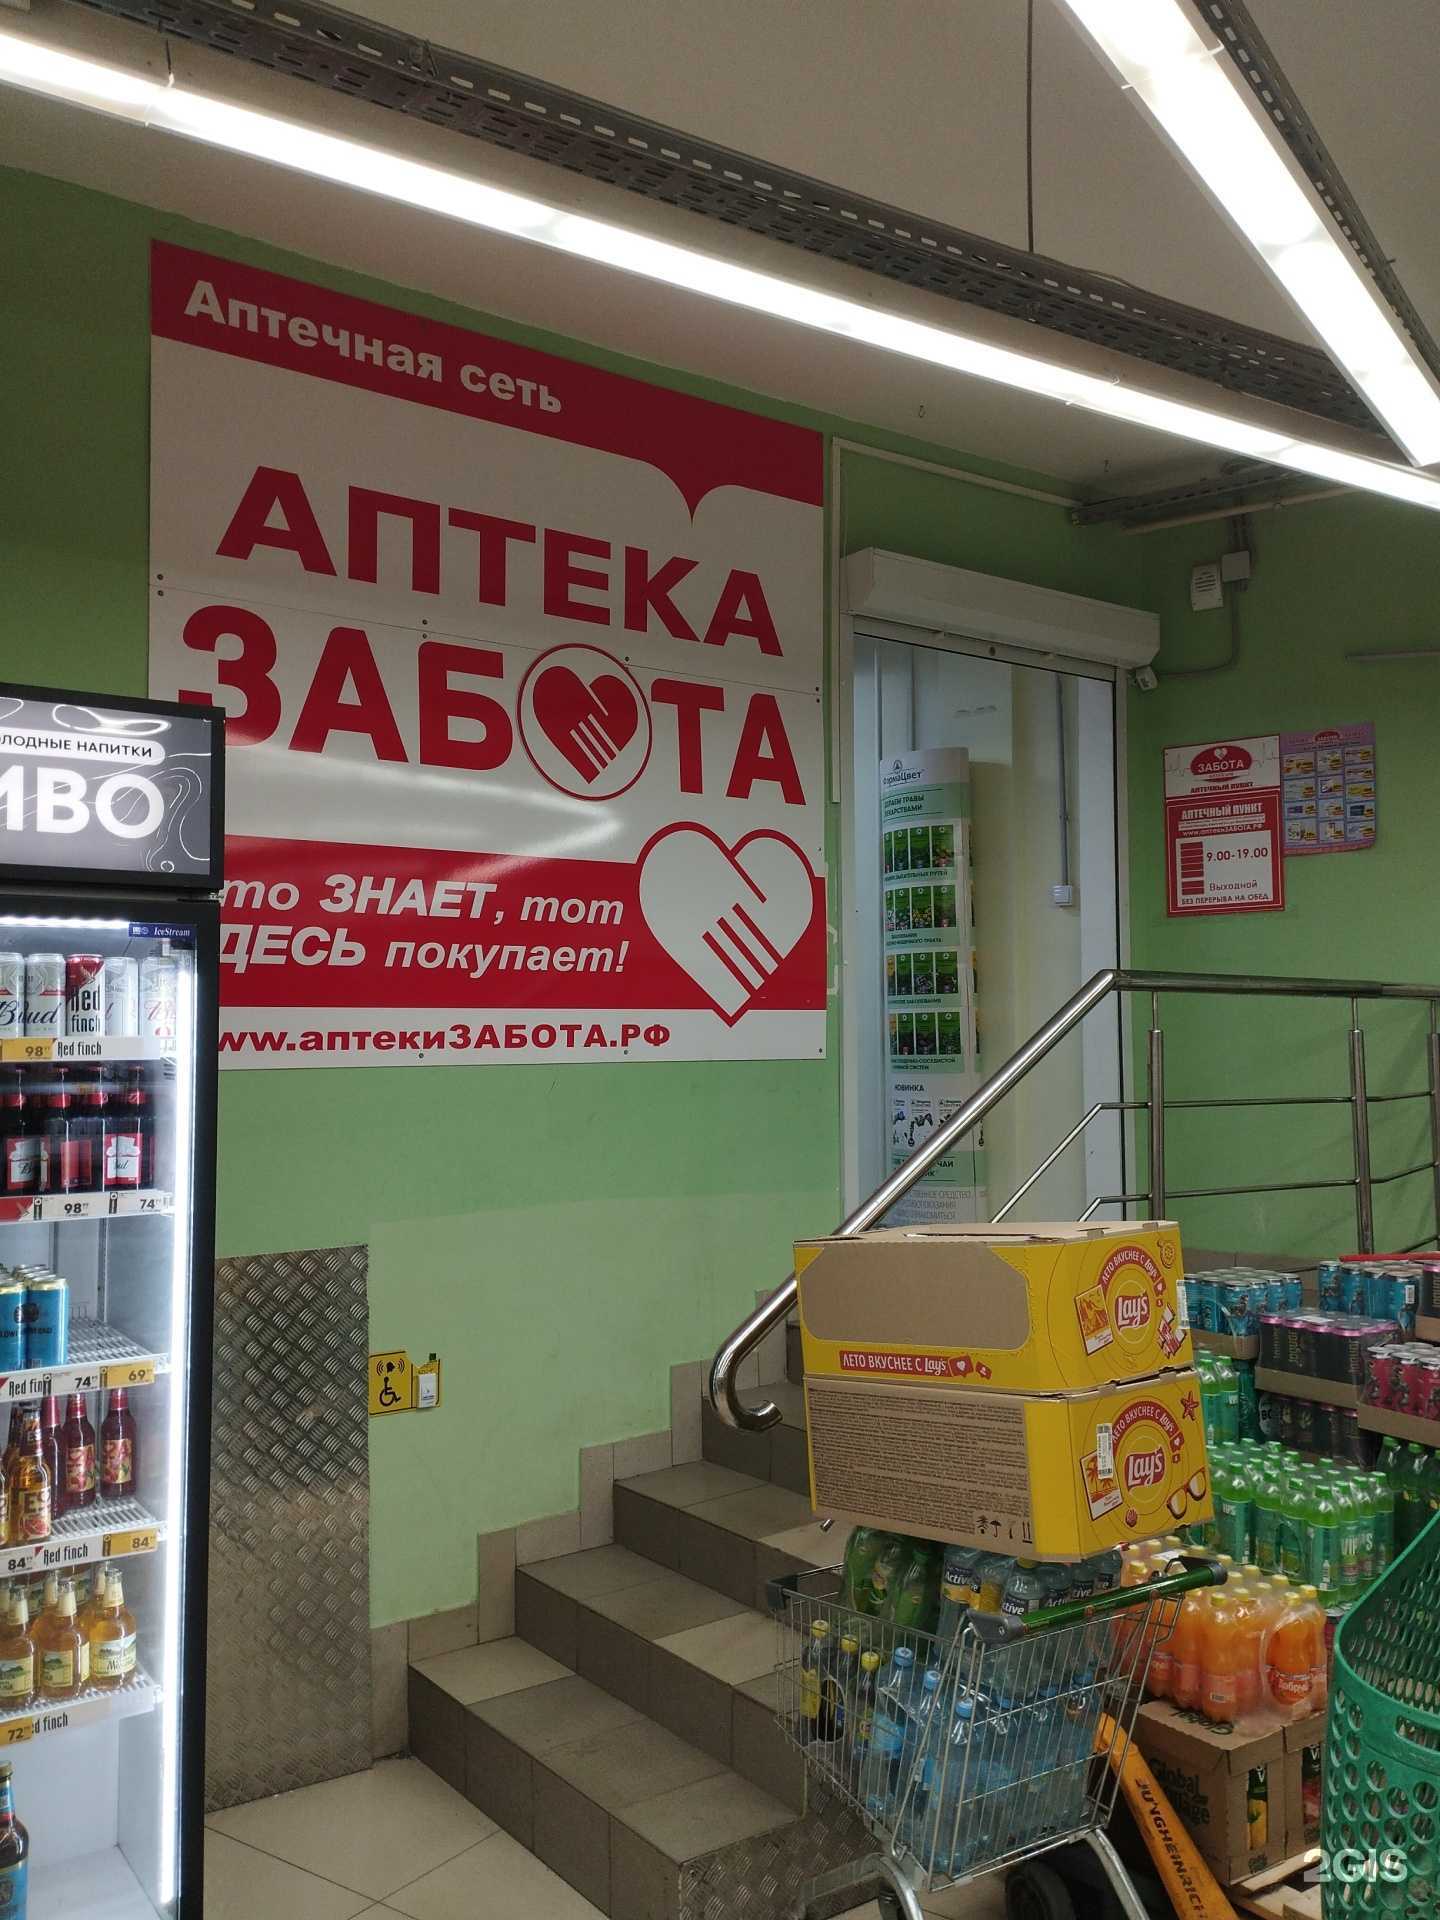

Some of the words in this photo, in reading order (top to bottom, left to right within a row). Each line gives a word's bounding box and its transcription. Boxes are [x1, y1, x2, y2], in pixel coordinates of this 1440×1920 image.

[183, 279, 443, 383] Аптечная
[459, 362, 563, 414] сеть
[214, 465, 784, 657] АПТЕКА
[0, 734, 71, 752] ЛОДНЫЕ
[77, 741, 153, 758] НАПИТКИ
[1197, 759, 1245, 774] ЗАБОТА
[0, 765, 165, 839] ИВО
[1181, 804, 1232, 820] АПТЕЧНЫЙ
[1232, 802, 1263, 815] ПУНКТ
[1206, 847, 1269, 862] 9.00-19.00
[1209, 880, 1258, 892] Выходной
[219, 879, 300, 911] то
[319, 874, 503, 925] ЗНАЕТ,
[520, 892, 624, 925] тот
[1234, 894, 1246, 902] НА
[153, 926, 191, 938] IceStream
[219, 922, 367, 974] ДЕСЬ
[385, 938, 629, 979] покупает!
[217, 1023, 671, 1053] ww.аптекиЗАБОТА.РФ
[25, 1046, 44, 1058] 98
[57, 1041, 75, 1058] Red
[77, 1040, 102, 1057] finch
[64, 1202, 82, 1215] 98
[141, 1198, 155, 1210] 74
[1101, 1262, 1115, 1284] ЛЕТО
[1116, 1292, 1149, 1329] Lay's
[843, 1352, 866, 1368] ЛЕТО
[868, 1355, 913, 1371] ВКУСНЕЕ
[915, 1357, 923, 1372] С
[924, 1357, 947, 1376] Lay's
[74, 1375, 92, 1389] 74
[128, 1369, 146, 1382] 69
[8, 1380, 27, 1398] Red
[1127, 1449, 1164, 1487] Lay's
[132, 1536, 149, 1549] 84
[43, 1549, 60, 1566] Red
[63, 1543, 88, 1561] finch
[8, 1557, 26, 1571] 84
[42, 1712, 69, 1731] finch
[7, 1727, 24, 1741] 72
